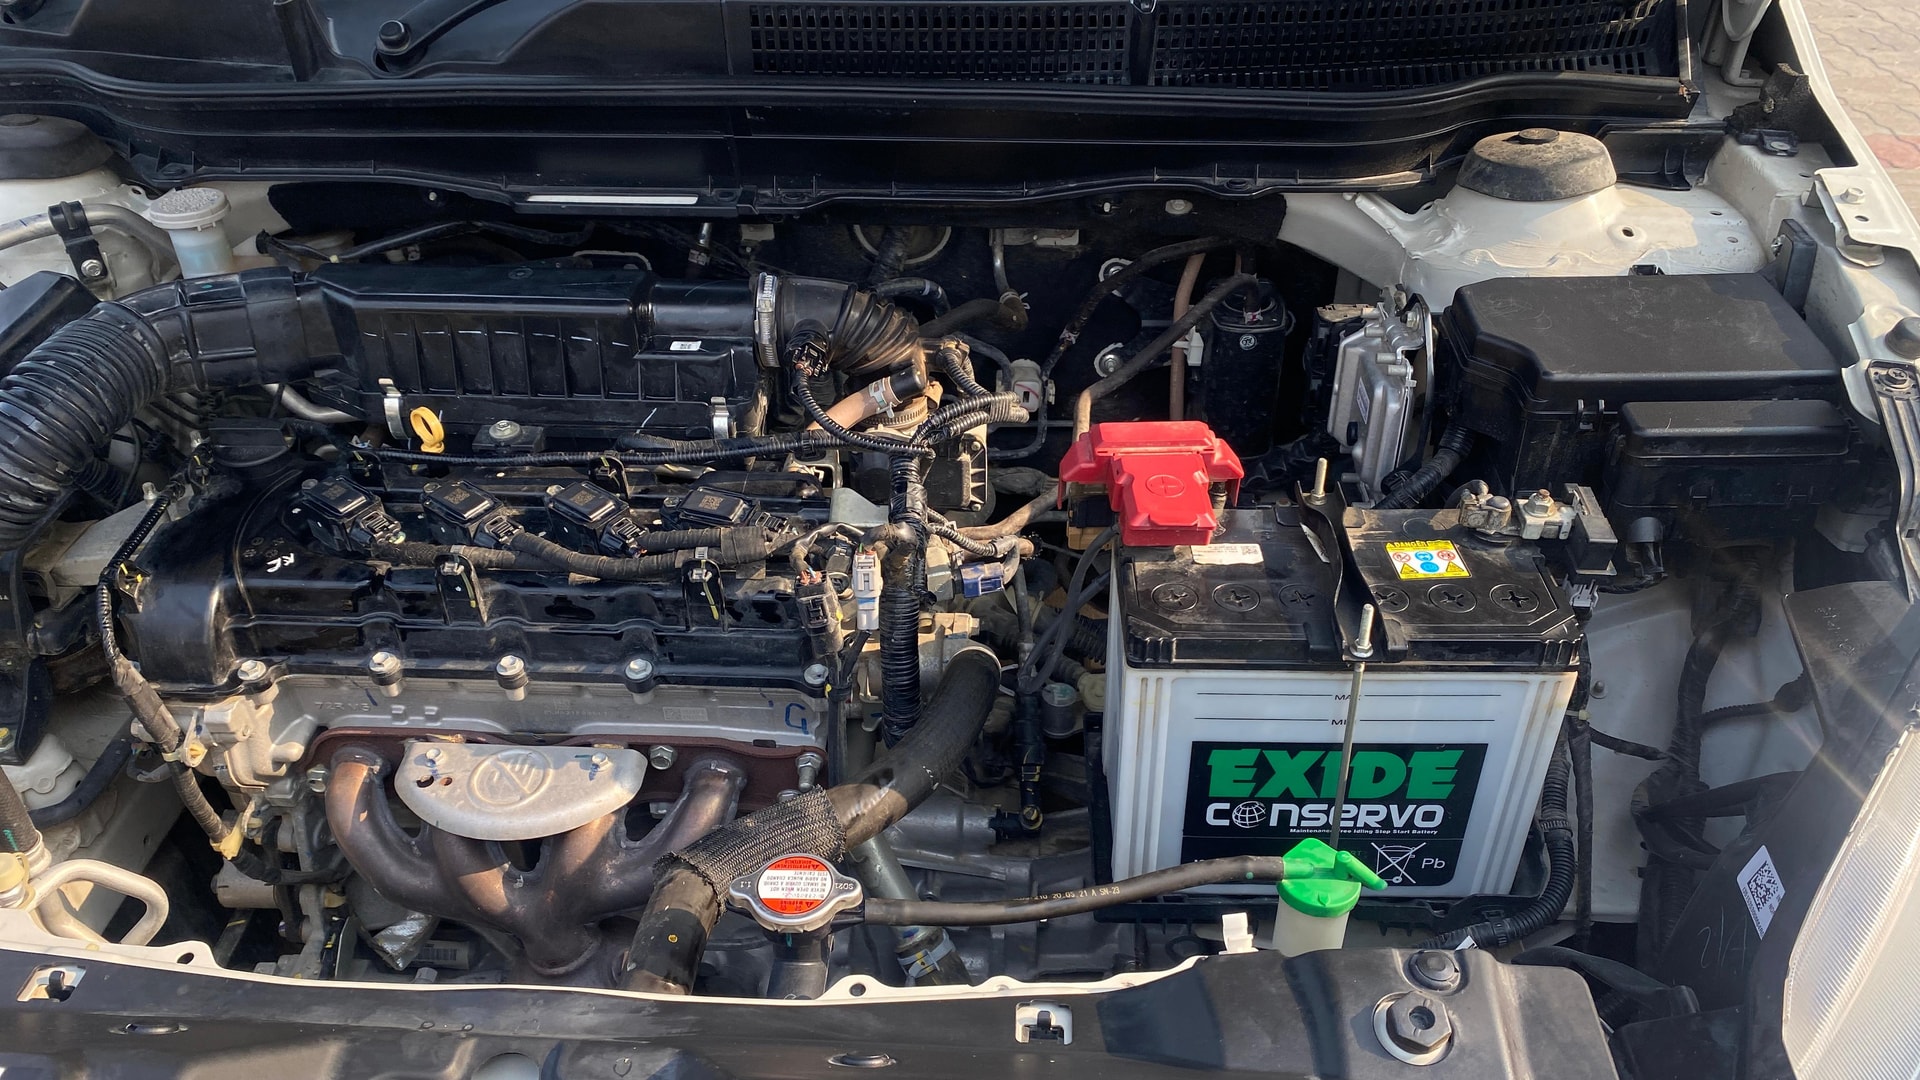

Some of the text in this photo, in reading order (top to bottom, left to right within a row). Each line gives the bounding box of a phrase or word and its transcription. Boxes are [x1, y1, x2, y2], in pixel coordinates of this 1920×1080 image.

[1207, 748, 1465, 800] EXIDE
[1421, 857, 1446, 869] Pb
[1099, 886, 1121, 896] SN-23
